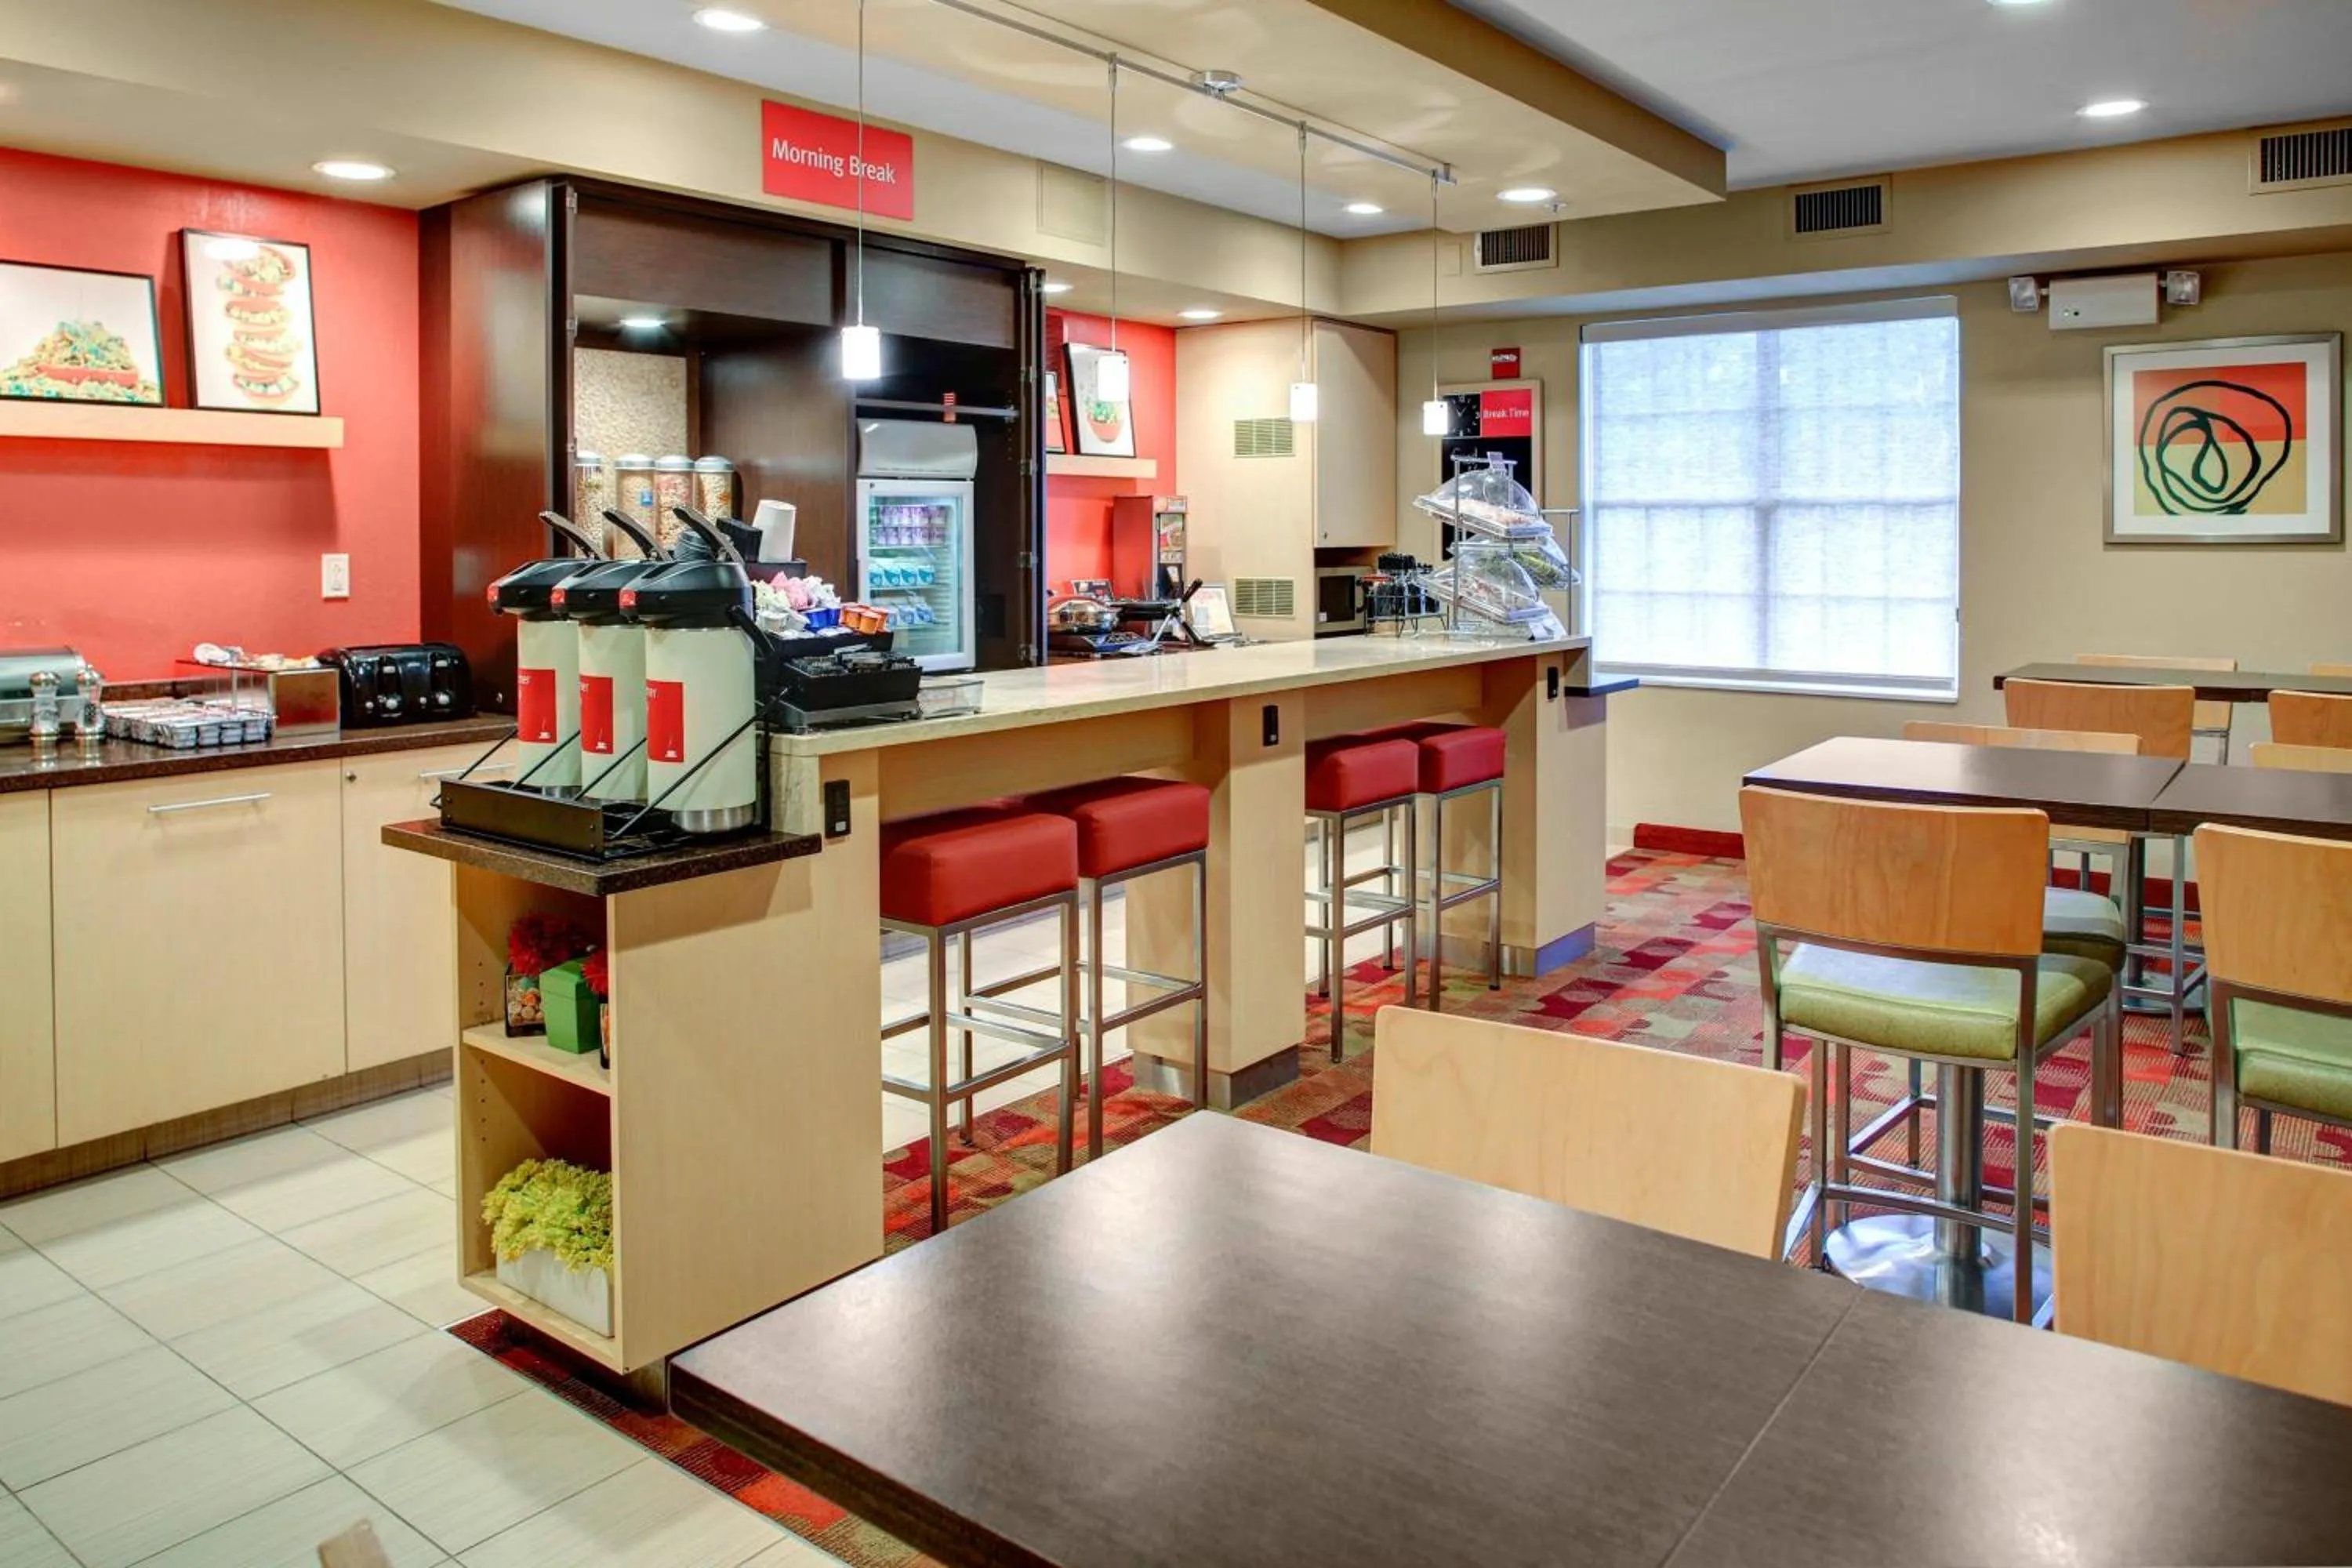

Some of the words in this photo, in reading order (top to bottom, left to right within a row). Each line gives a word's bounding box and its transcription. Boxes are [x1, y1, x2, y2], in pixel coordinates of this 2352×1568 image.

[772, 137, 844, 178] Morning
[849, 155, 896, 185] Break
[1483, 408, 1507, 419] Break
